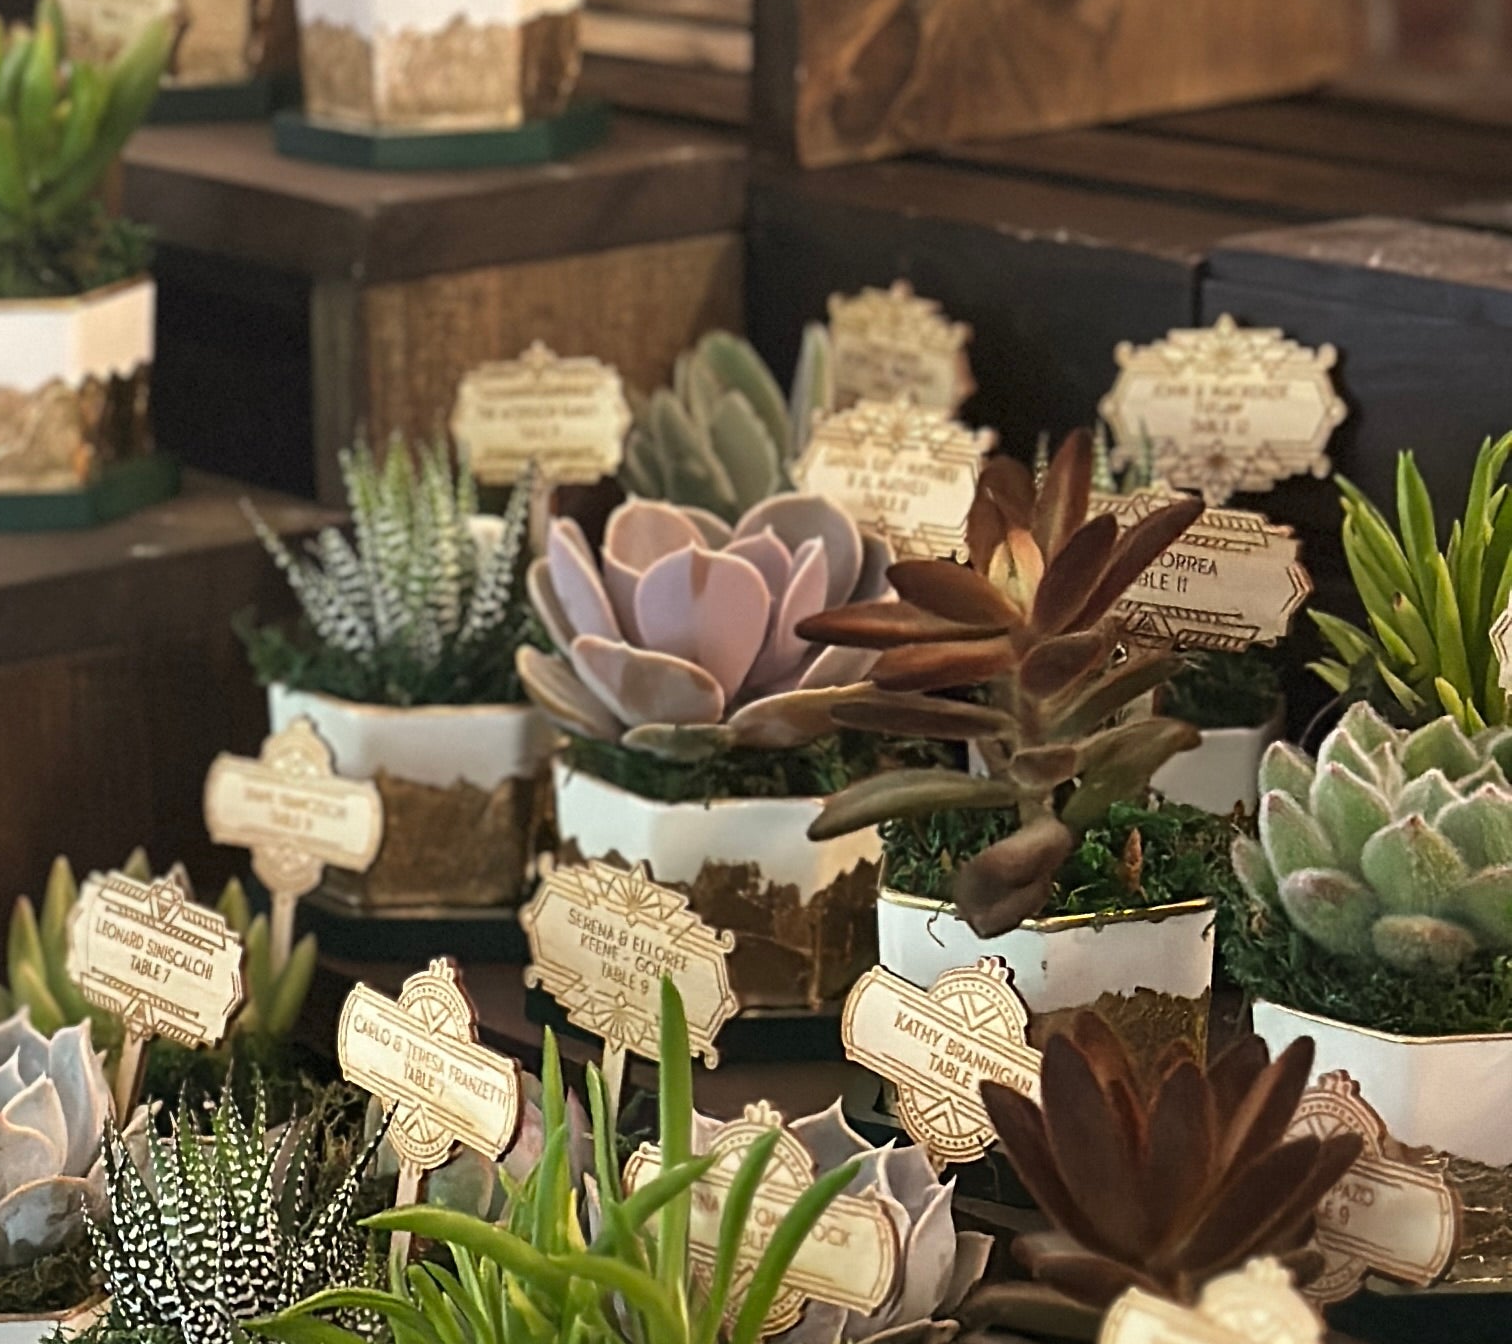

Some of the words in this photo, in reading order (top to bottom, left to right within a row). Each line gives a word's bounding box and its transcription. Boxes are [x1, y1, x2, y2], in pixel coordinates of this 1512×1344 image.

[1152, 551, 1218, 576] ORREA
[1138, 571, 1169, 591] BLE
[95, 917, 144, 951] LEONARD
[145, 938, 214, 981] SINISCALCHI
[568, 907, 614, 941] SERENA
[618, 929, 628, 947] &
[632, 936, 688, 973] ELLOREE
[580, 934, 619, 961] KEENE
[130, 954, 161, 982] TABLE
[601, 961, 635, 991] TABLE
[893, 1010, 943, 1048] KATHY
[944, 1037, 1033, 1093] BRANNIGAN
[403, 1060, 435, 1091] TABLE
[406, 1037, 445, 1076] TERESA
[448, 1064, 508, 1109] FRANZETTI
[929, 1051, 973, 1091] TABLE
